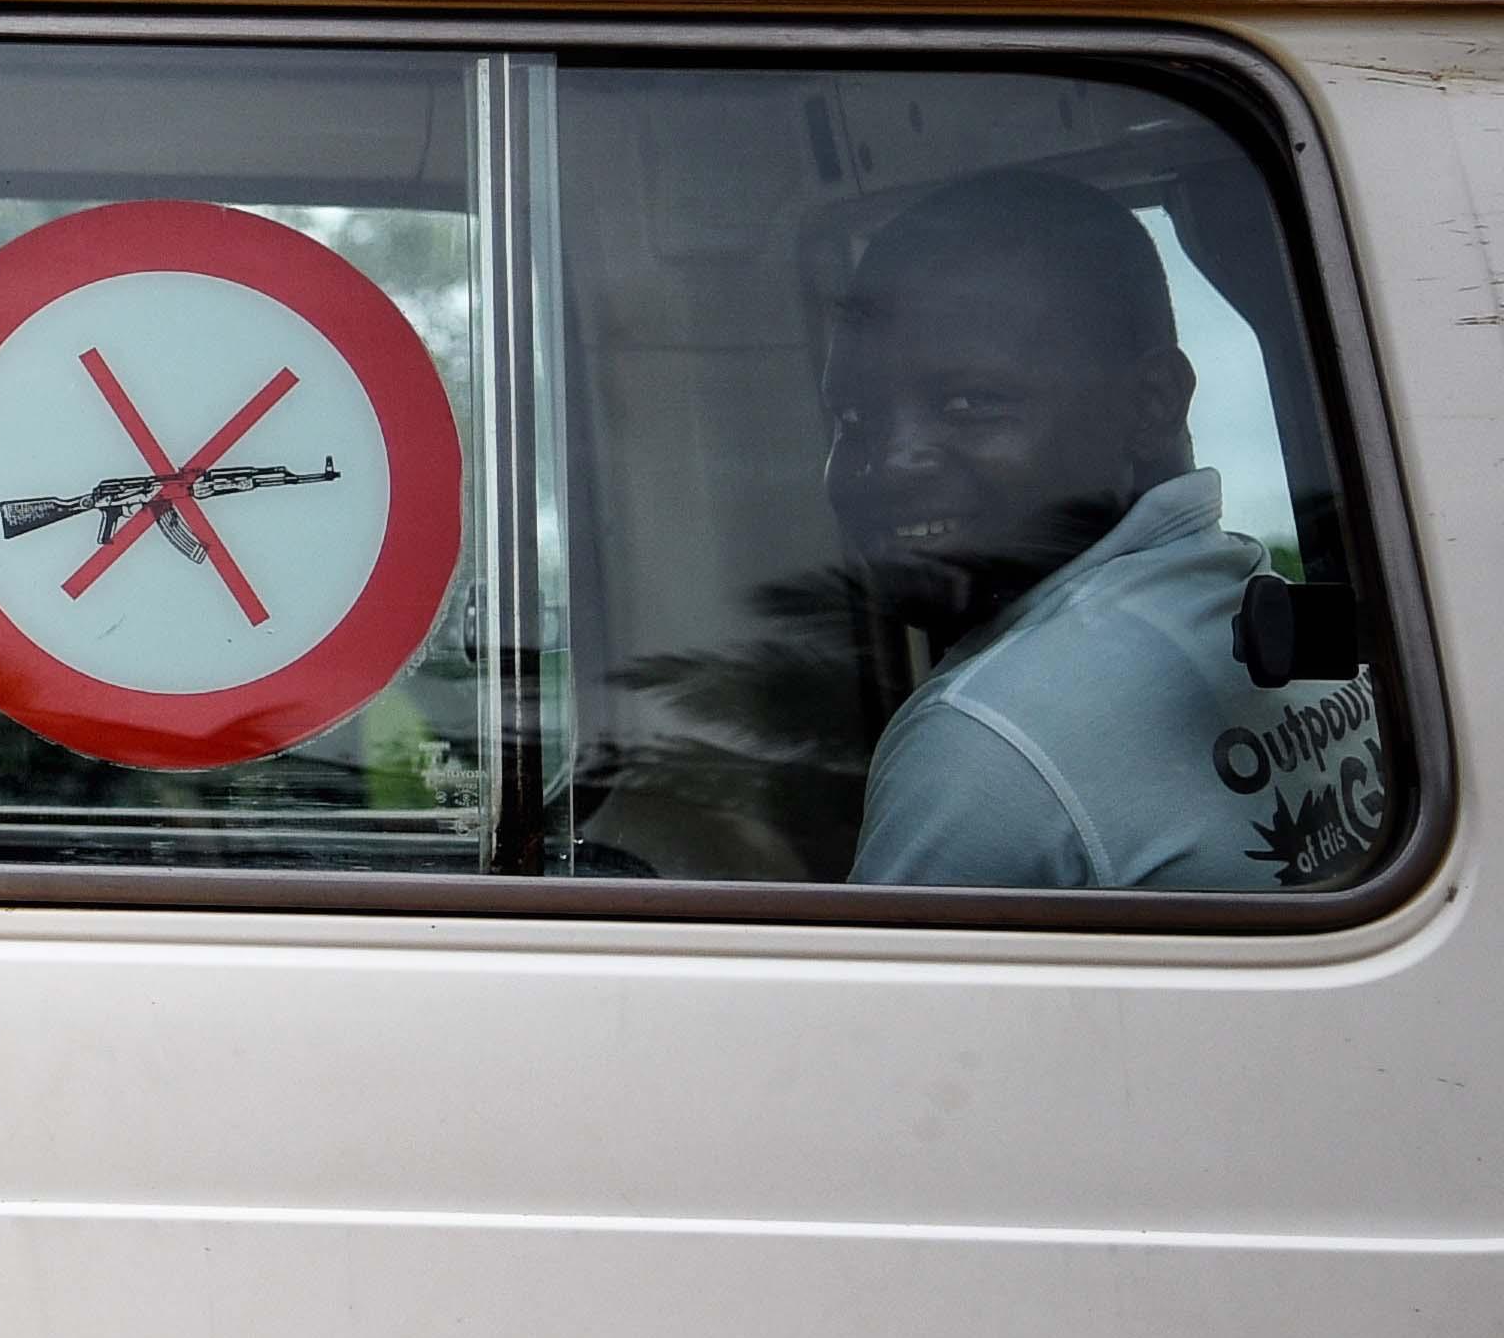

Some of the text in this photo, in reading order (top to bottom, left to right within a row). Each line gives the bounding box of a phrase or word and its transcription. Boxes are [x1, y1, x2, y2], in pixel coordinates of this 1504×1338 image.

[1213, 670, 1373, 794] Outpour
[1296, 835, 1319, 874] of
[1319, 822, 1349, 861] His
